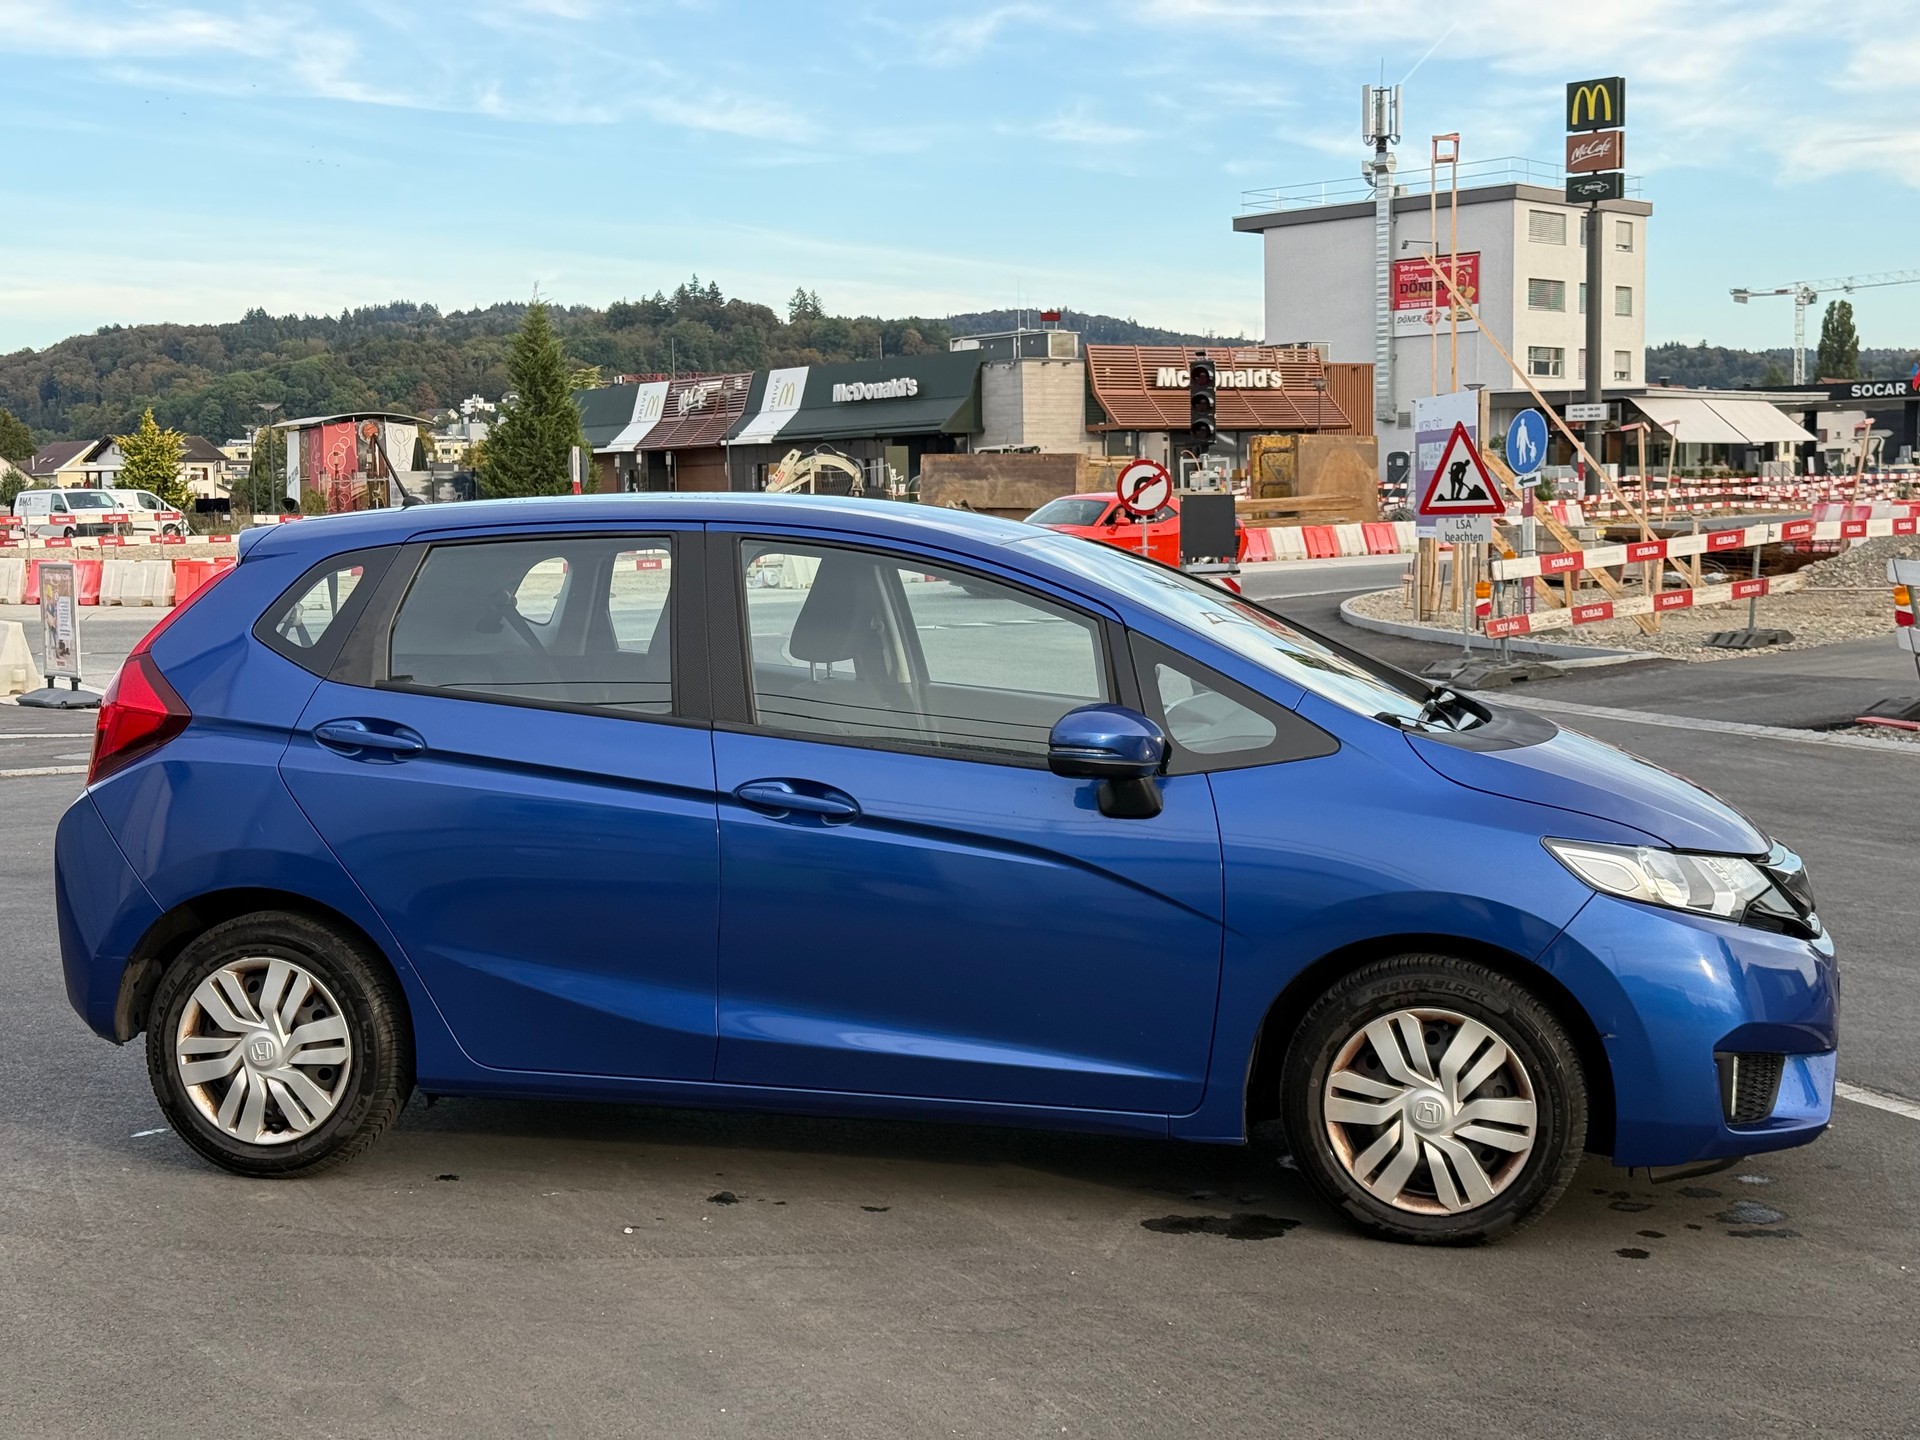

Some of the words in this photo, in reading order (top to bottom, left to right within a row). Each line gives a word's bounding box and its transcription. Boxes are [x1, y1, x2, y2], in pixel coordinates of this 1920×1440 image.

[832, 377, 918, 402] McDonald's
[1851, 382, 1907, 397] SOCAR
[1455, 519, 1472, 529] LSA
[1790, 524, 1810, 534] KIBAG
[1847, 524, 1862, 533] KIBAG
[1898, 521, 1912, 530] KIBAG
[1445, 531, 1483, 542] beachten
[1716, 535, 1737, 545] KIBAG
[1636, 545, 1659, 556] KIBAG
[1551, 557, 1574, 568] KIBAG
[1740, 584, 1760, 594] KIBAG
[1662, 595, 1684, 605] KIBAG
[1581, 607, 1604, 618] KIBAG
